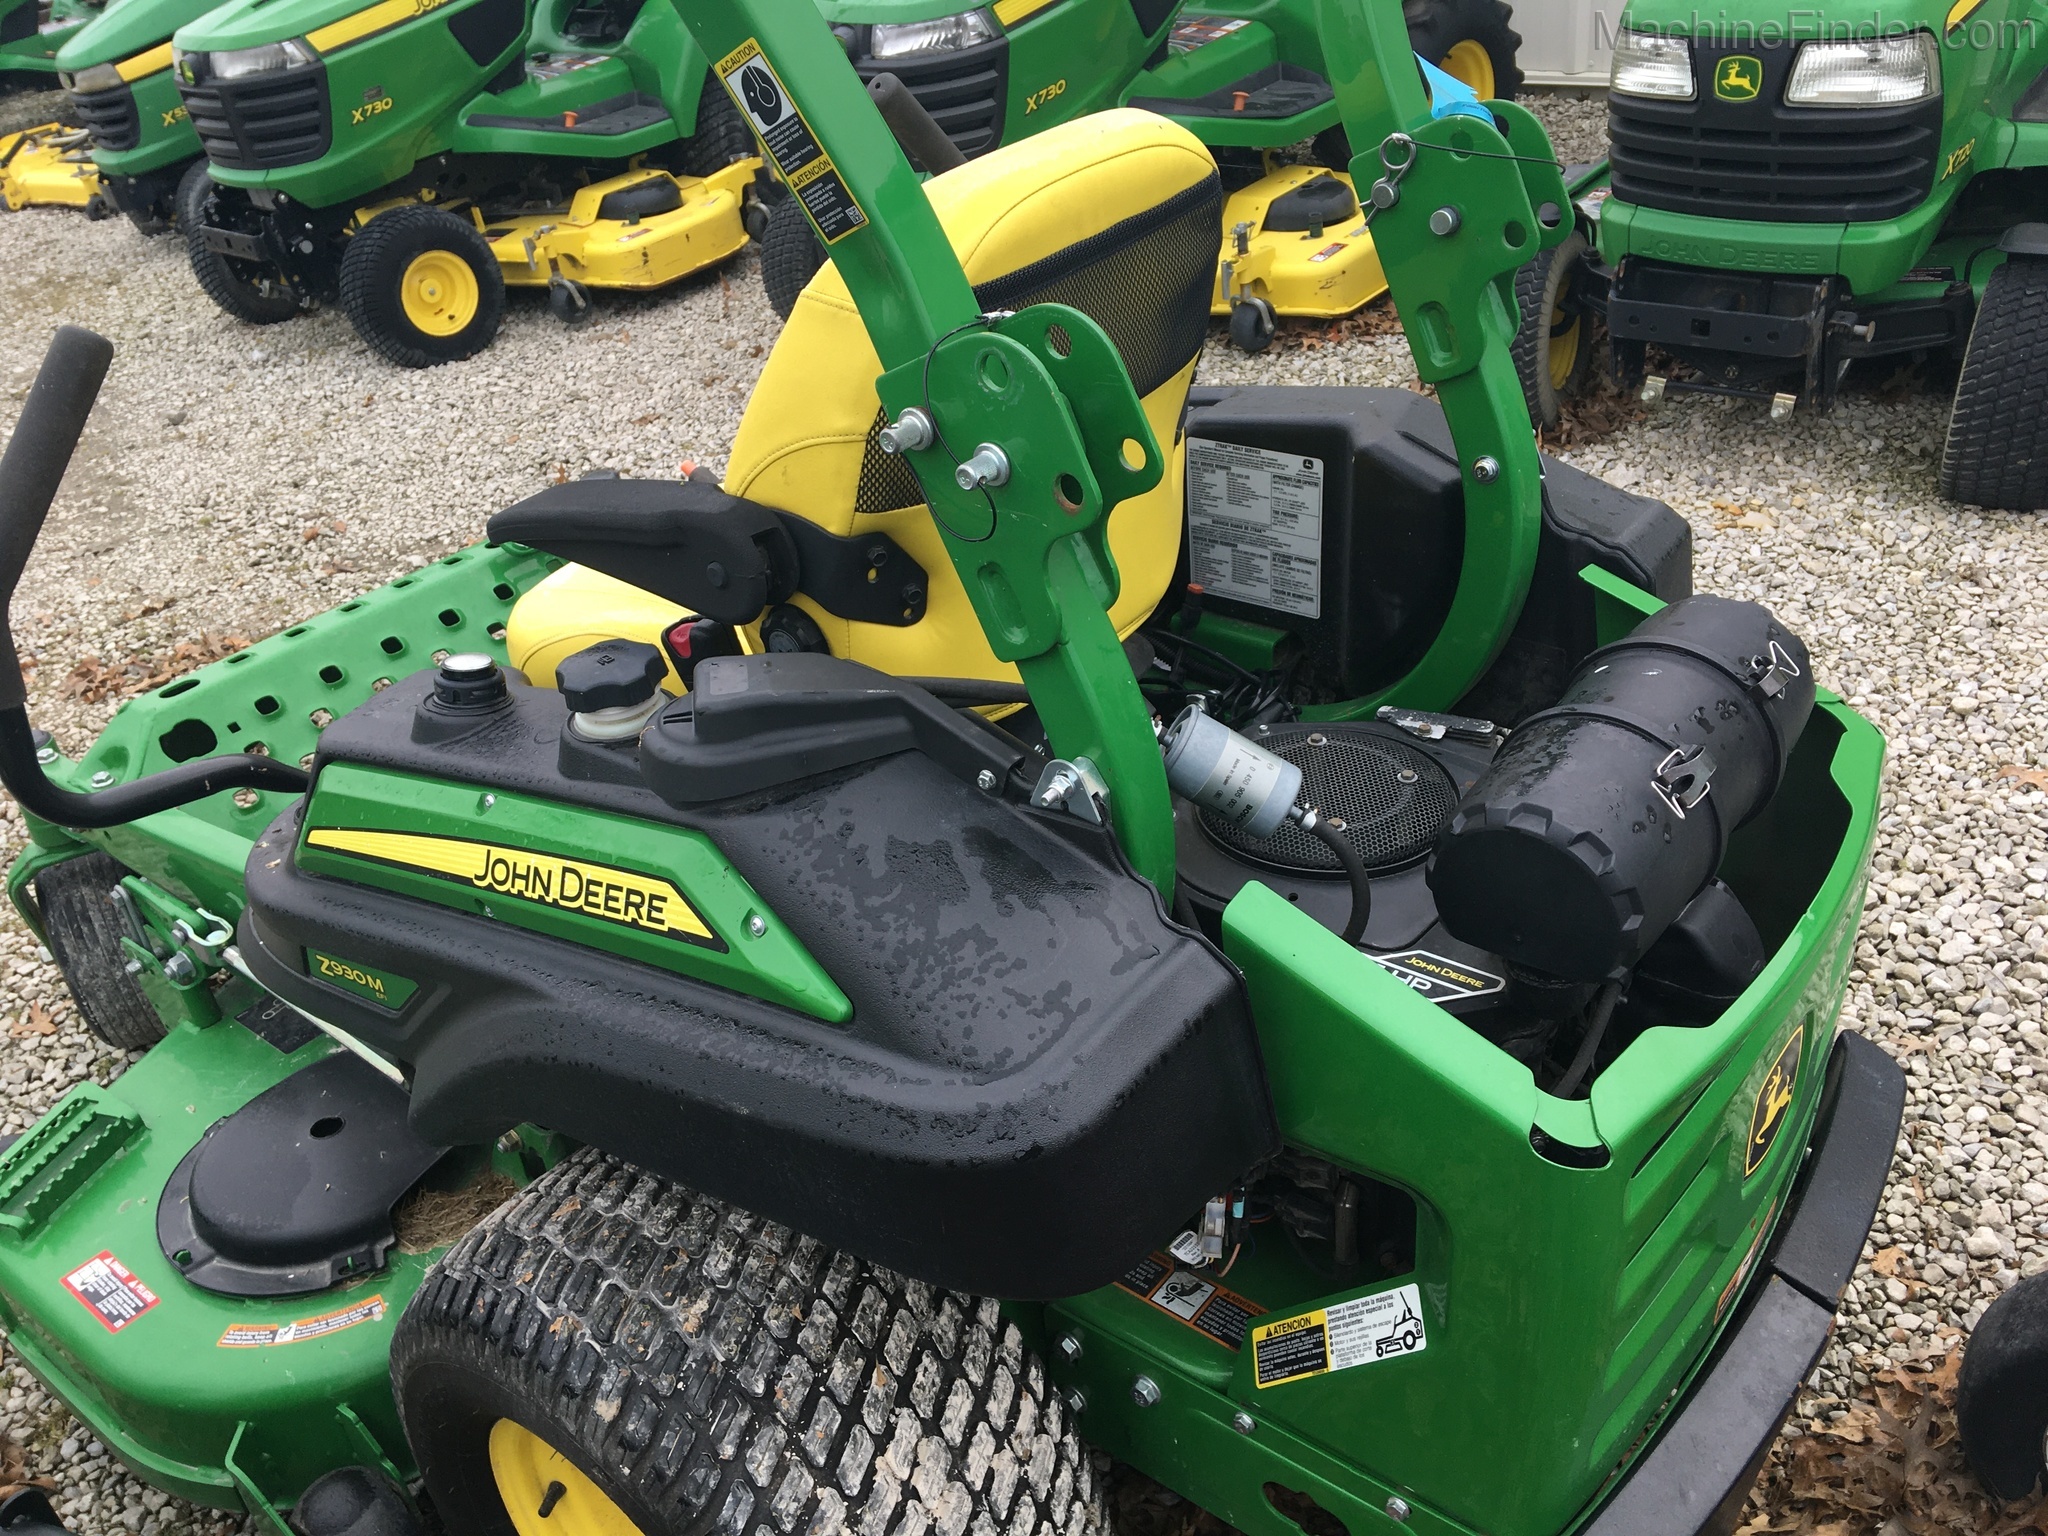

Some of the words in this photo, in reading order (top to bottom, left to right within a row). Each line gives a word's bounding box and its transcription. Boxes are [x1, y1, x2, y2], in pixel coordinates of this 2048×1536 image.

[725, 43, 757, 70] CAUTION
[352, 97, 393, 125] X730
[1024, 79, 1067, 115] X730
[796, 158, 832, 186] ATENCIÓN
[1941, 138, 1976, 182] X720
[1640, 234, 1711, 263] JOHN
[1718, 243, 1820, 271] DEERE
[1235, 786, 1245, 798] 905
[1242, 774, 1252, 785] 450
[473, 848, 553, 897] JOHN
[560, 868, 668, 926] DEERE
[315, 954, 385, 993] Z930M
[1404, 957, 1441, 974] JOHN
[1441, 968, 1485, 988] DEERE
